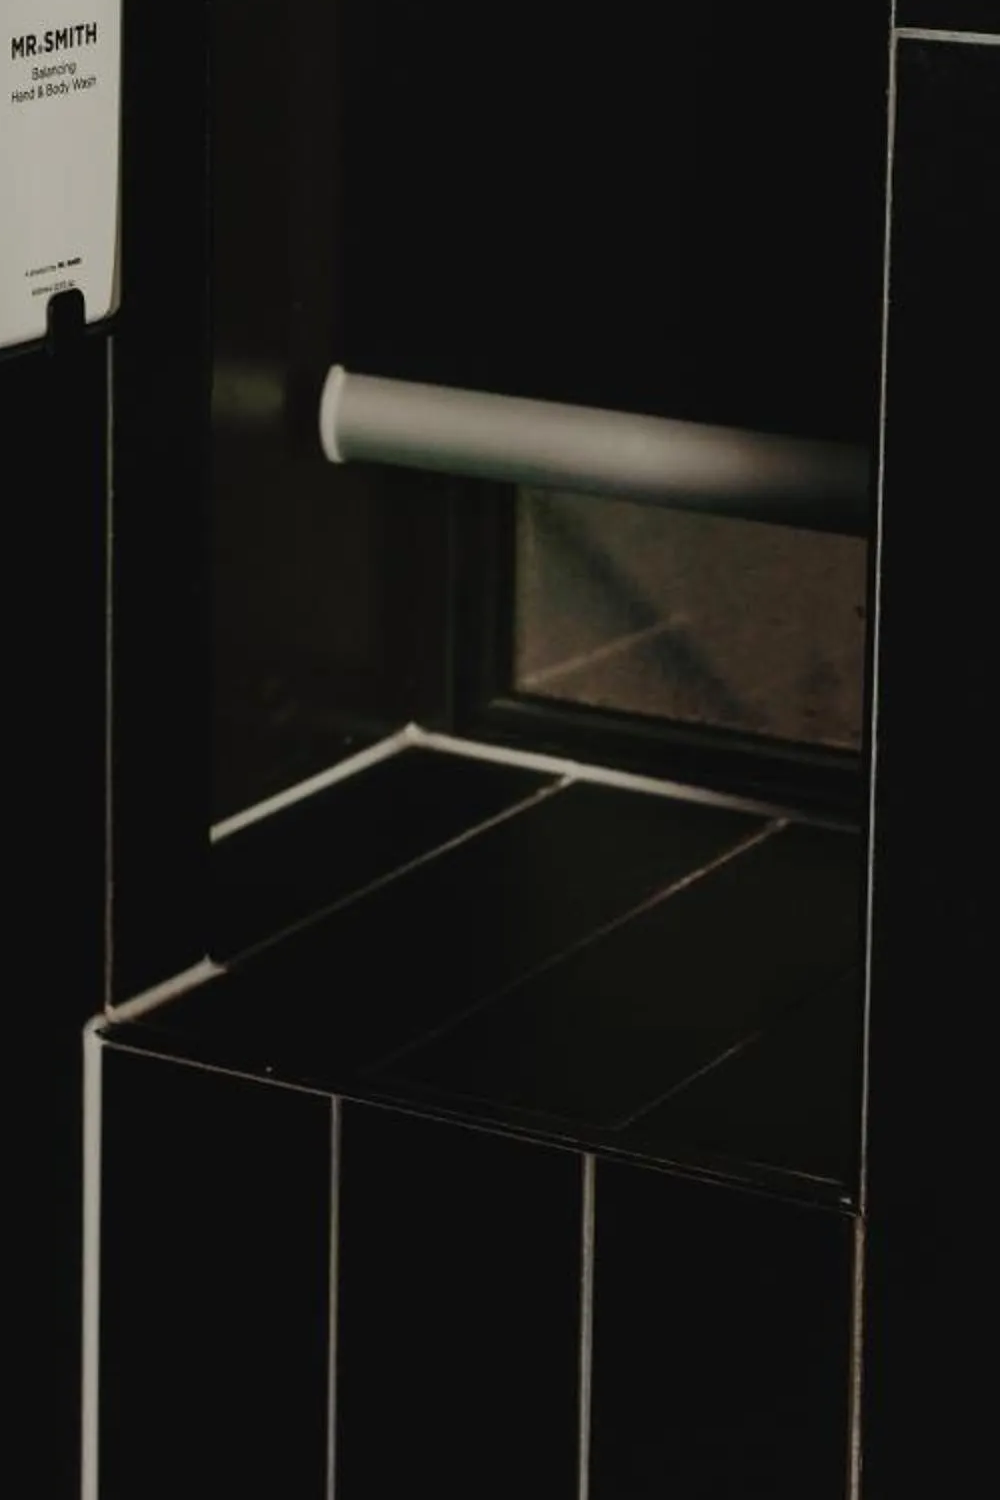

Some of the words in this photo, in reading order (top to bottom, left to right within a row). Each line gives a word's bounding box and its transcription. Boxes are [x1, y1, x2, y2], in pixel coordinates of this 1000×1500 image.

[32, 62, 77, 80] Balancing
[11, 86, 35, 103] Hand
[46, 80, 70, 97] Body
